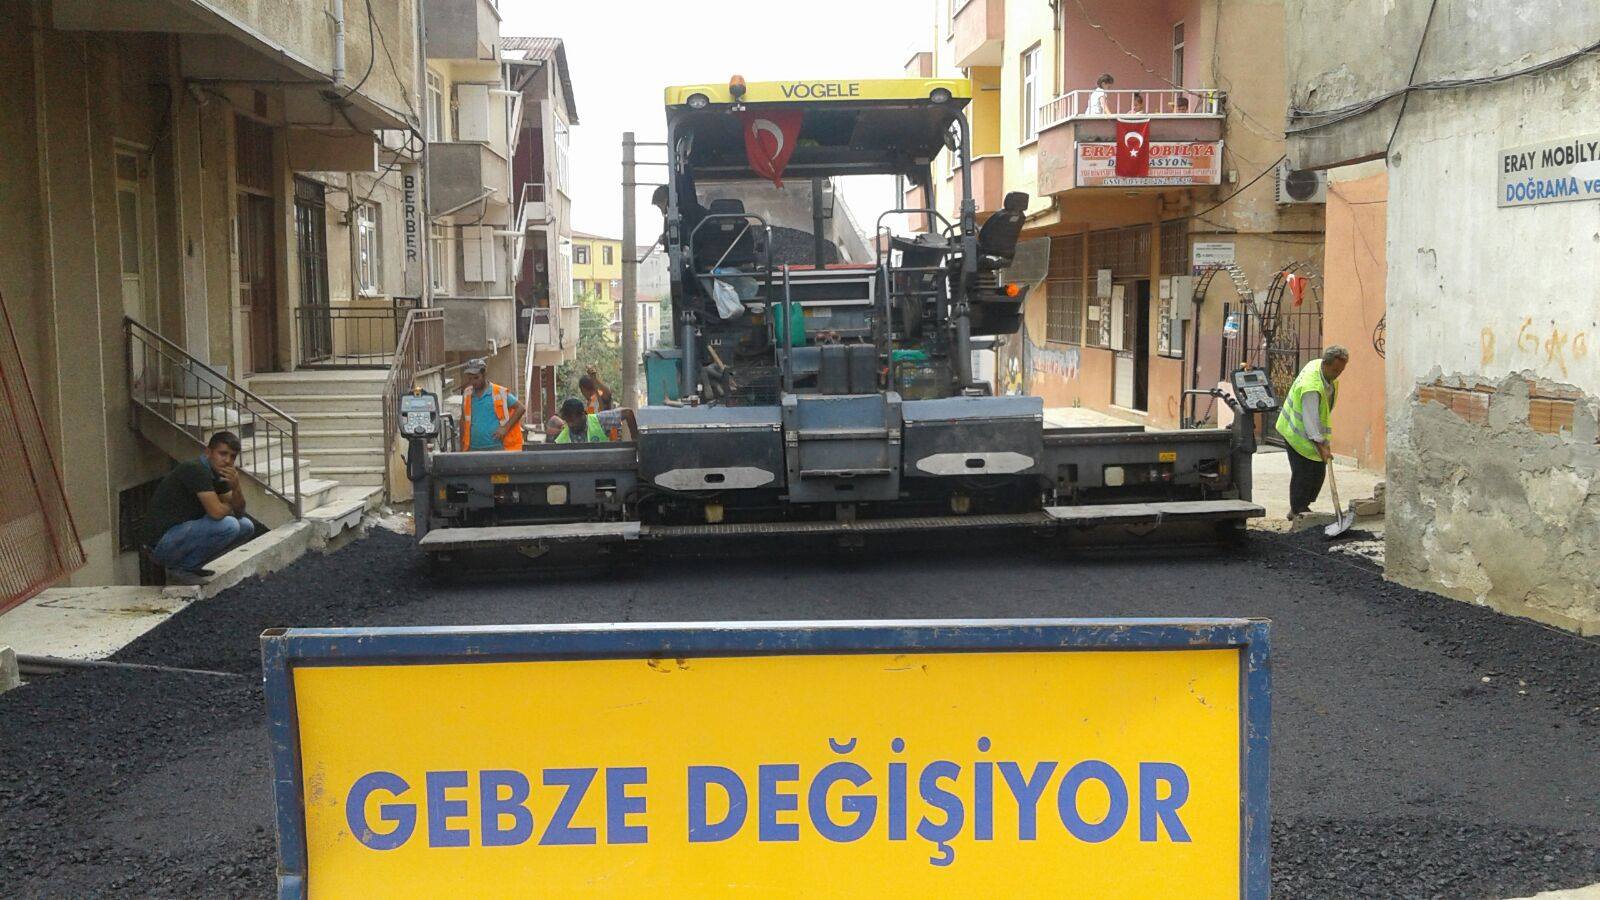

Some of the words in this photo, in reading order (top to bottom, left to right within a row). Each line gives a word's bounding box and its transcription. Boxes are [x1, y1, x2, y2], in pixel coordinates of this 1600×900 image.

[1081, 146, 1117, 158] ERA
[1504, 151, 1536, 173] ERAY
[1542, 140, 1600, 168] MOBİLY
[1506, 177, 1579, 202] DOĞRAMA
[1584, 179, 1600, 194] ve
[404, 175, 417, 263] BERBER
[345, 766, 649, 851] GEBZE
[687, 735, 1193, 867] DEĞİŞİYOR
